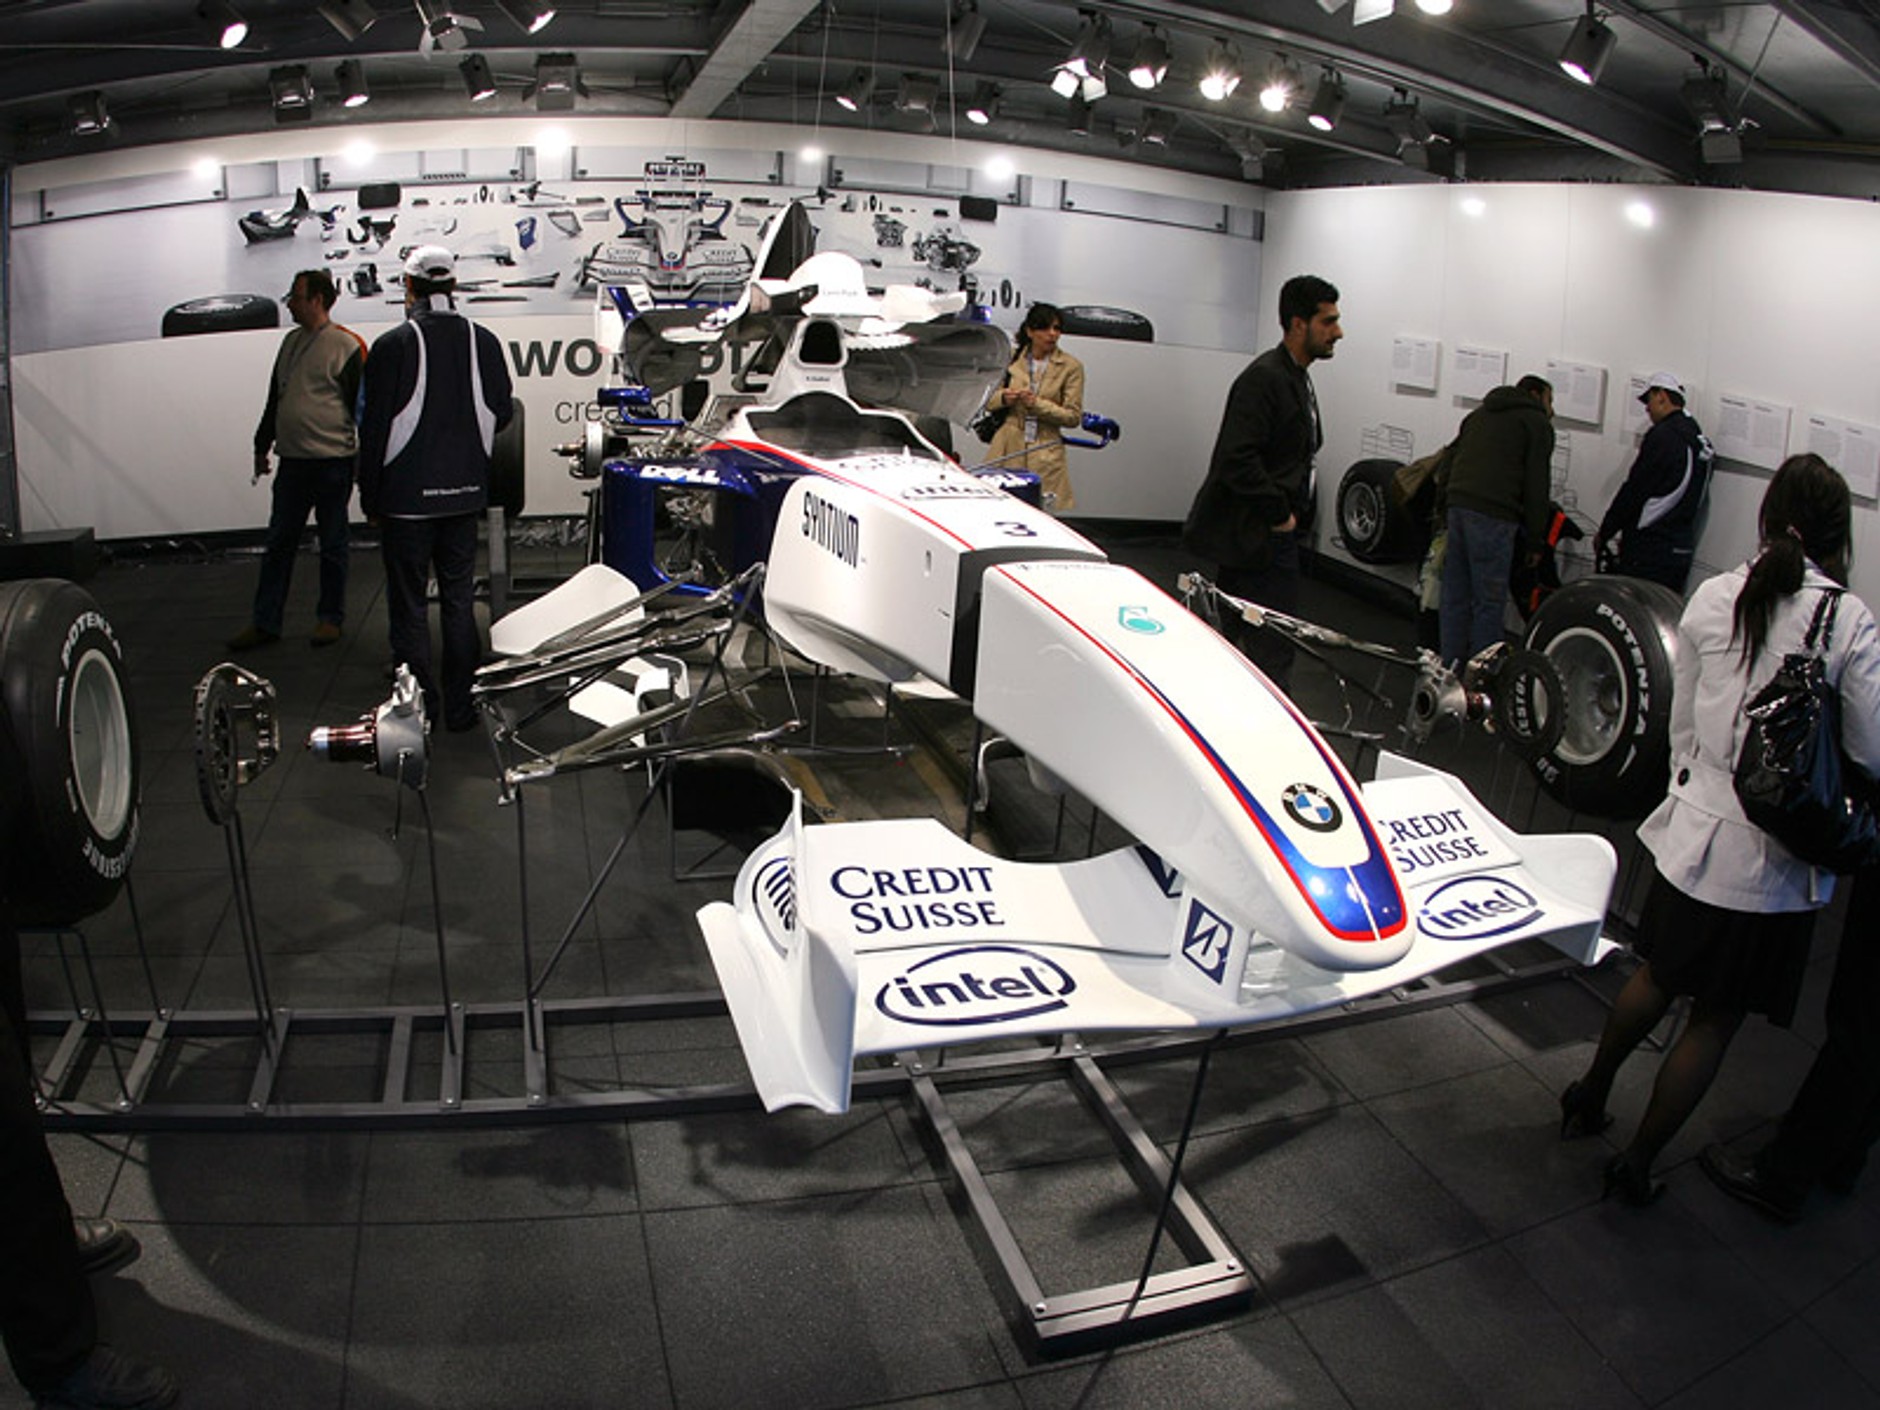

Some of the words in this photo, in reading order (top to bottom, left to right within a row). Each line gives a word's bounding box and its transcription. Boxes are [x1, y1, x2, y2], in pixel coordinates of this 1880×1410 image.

[640, 464, 720, 485] DELL
[994, 520, 1038, 537] 3
[1596, 603, 1649, 735] POTENZA
[830, 866, 995, 899] CREDIT
[850, 902, 1006, 934] SUISSE
[1417, 886, 1529, 930] intel
[893, 966, 1055, 1008] intel
